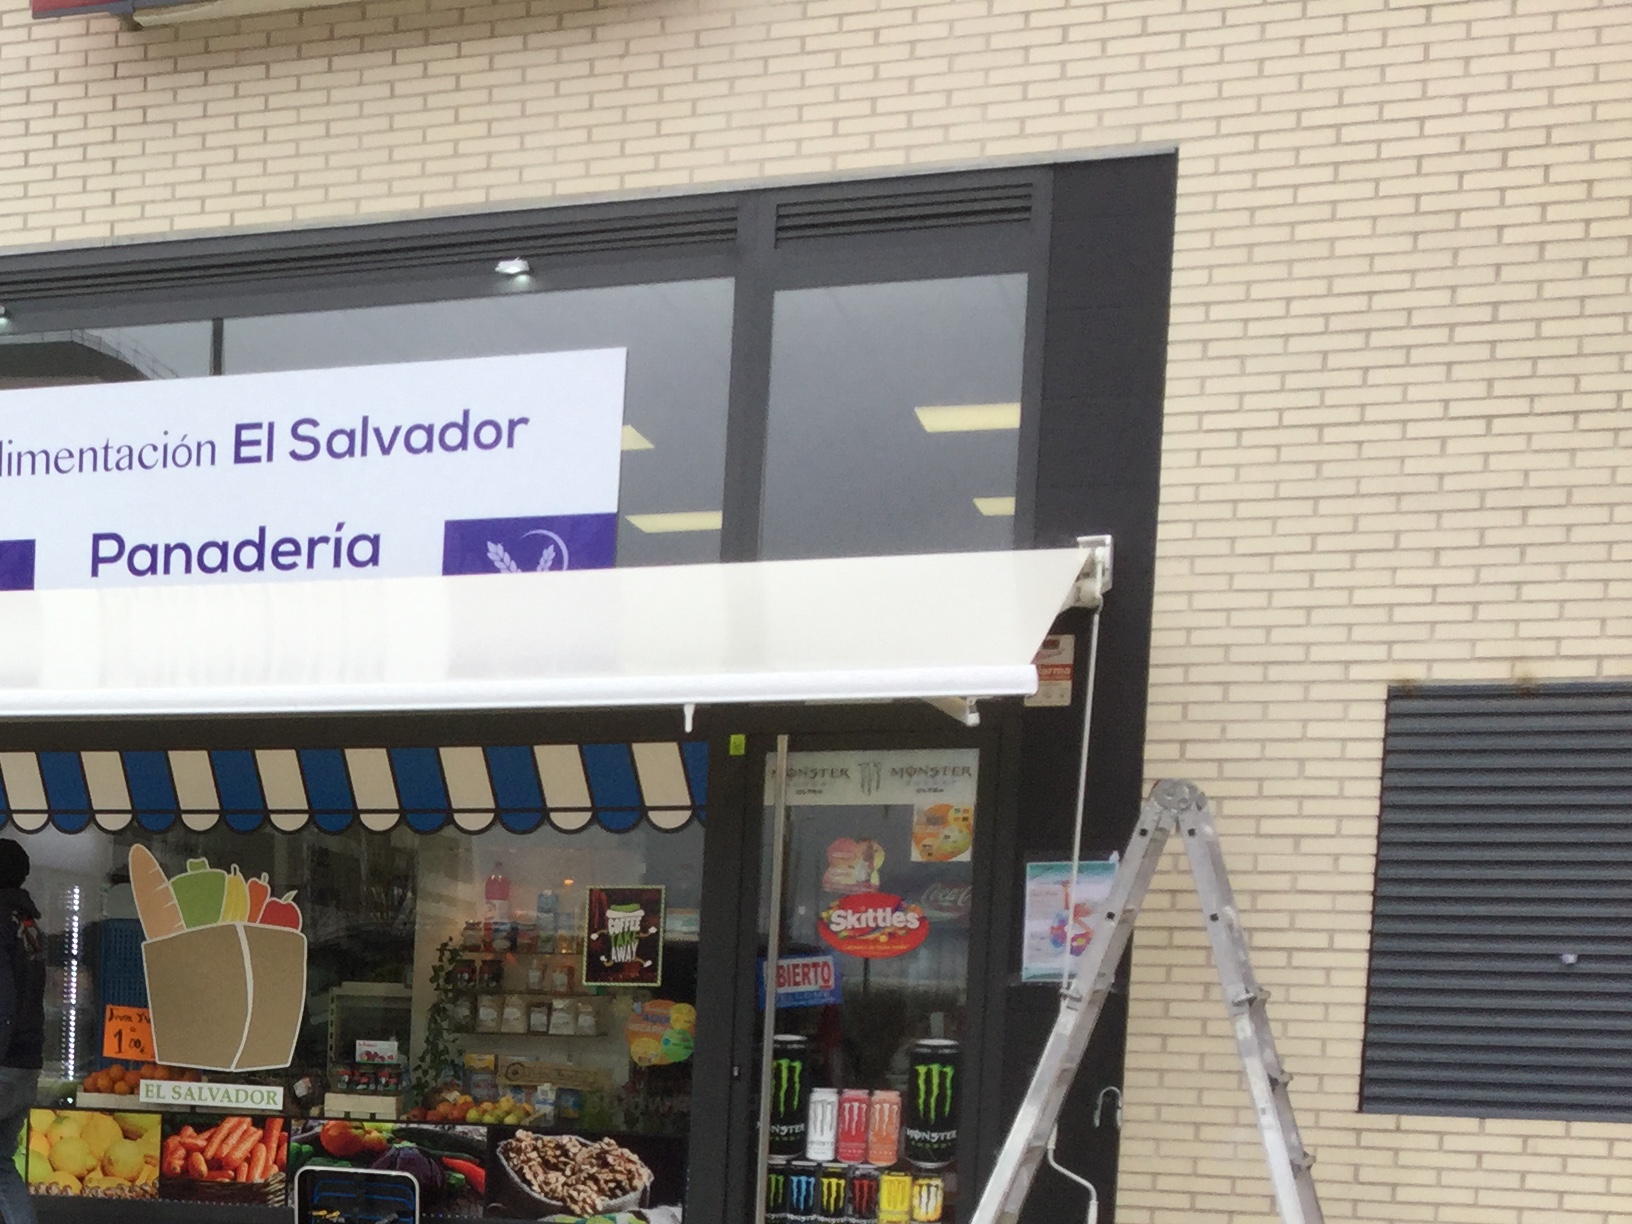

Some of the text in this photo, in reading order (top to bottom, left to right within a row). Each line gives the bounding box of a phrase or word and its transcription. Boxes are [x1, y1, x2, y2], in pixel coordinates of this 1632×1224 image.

[233, 422, 274, 464] El
[288, 409, 529, 462] Salvador
[91, 522, 381, 578] Panadería
[608, 917, 641, 935] COFFEE
[829, 907, 920, 931] Skittles
[611, 931, 639, 947] TAKE
[611, 944, 639, 963] AWAY
[777, 961, 832, 988] BIERTO
[144, 1083, 279, 1106] EL SALVADOR
